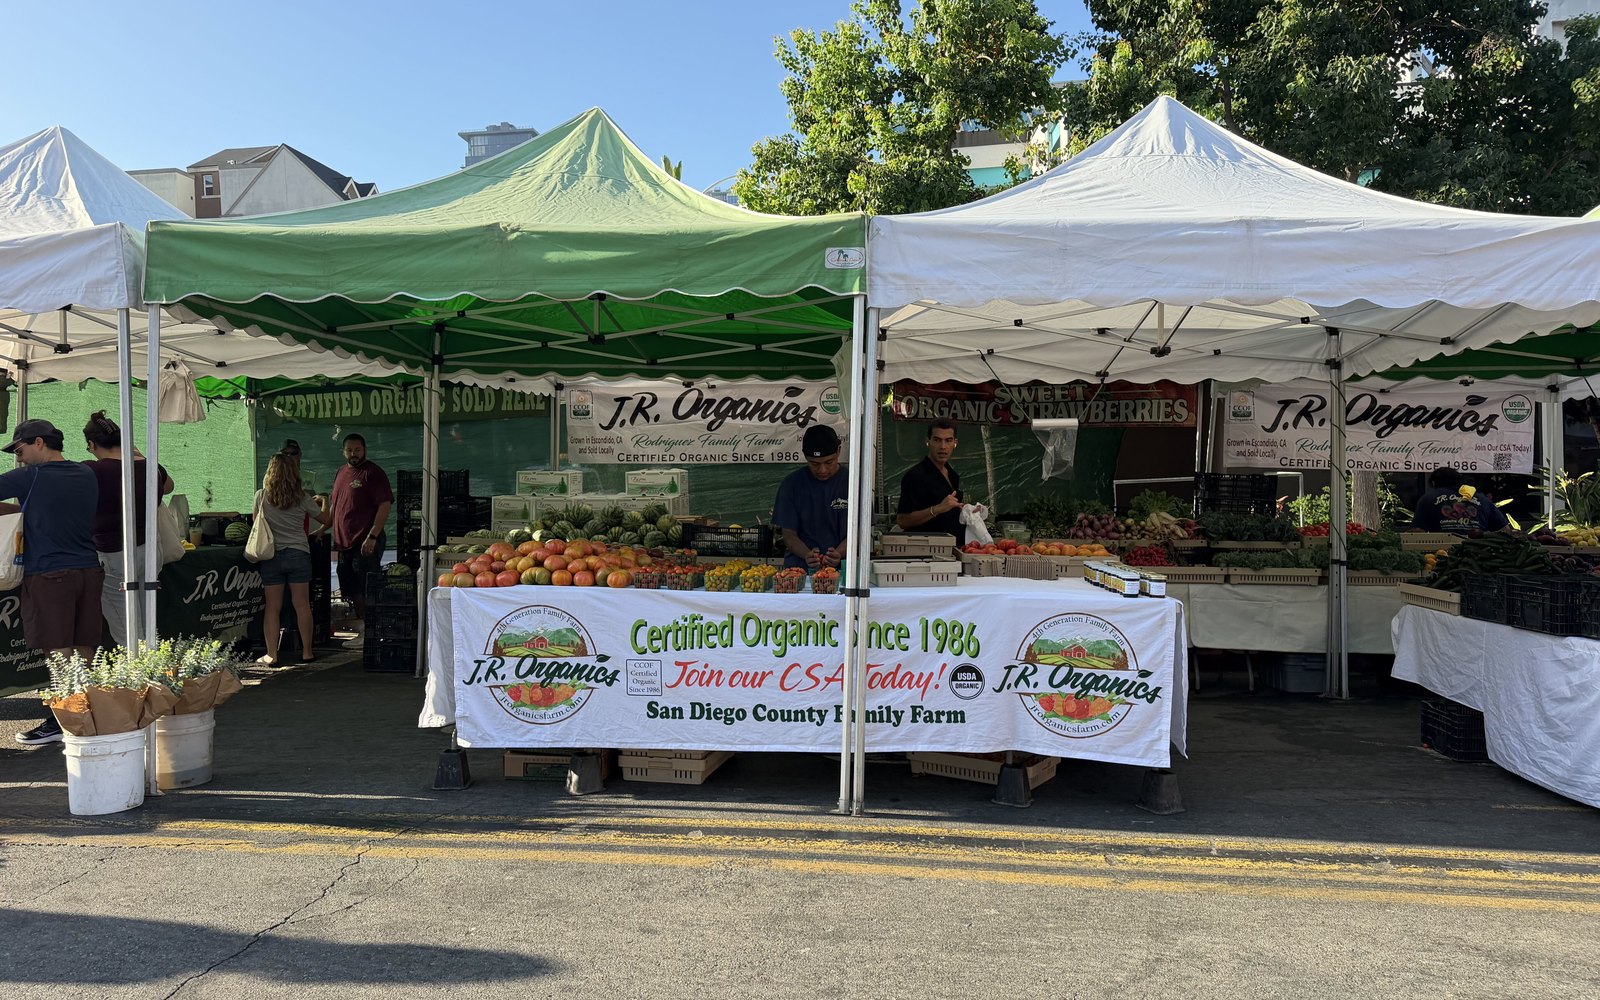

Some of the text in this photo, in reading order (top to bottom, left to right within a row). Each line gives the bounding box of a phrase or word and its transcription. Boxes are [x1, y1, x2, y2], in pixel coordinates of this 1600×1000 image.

[272, 386, 545, 418] CERTIFIED ORGANC SOLD HERE
[994, 385, 1088, 404] SWEET
[599, 388, 818, 431] J.R. Organics
[900, 395, 1189, 424] ORGANIC STRAWBERRIES
[1261, 393, 1500, 438] J.R. Organics
[570, 436, 584, 444] Grown
[591, 436, 616, 445] Escondido,
[616, 436, 623, 444] CA
[598, 446, 614, 456] Locally
[631, 434, 784, 452] Rodriguez Family Farms
[1226, 438, 1244, 446] Grown
[1252, 439, 1278, 448] Escondido,
[1367, 440, 1414, 459] Family
[1418, 440, 1462, 456] Farms
[1512, 444, 1532, 453] Today!
[618, 452, 799, 462] CERTIFIED ORGANIC SINCE 1986
[1247, 449, 1258, 457] Sold
[1259, 449, 1276, 459] Locally
[1280, 457, 1477, 471] CERTIFIE ORGANIC SINCE 1986
[1458, 517, 1469, 525] 40
[183, 570, 218, 604] J.R.
[497, 608, 582, 633] 4th Generation Family Farm
[1032, 616, 1125, 646] 4th Generation Family Farm
[630, 612, 980, 658] Certified Organic nce 1986
[462, 654, 620, 688] J.R. Organics
[665, 660, 726, 688] Join
[728, 670, 773, 688] our
[779, 663, 844, 692] CSA
[957, 672, 977, 681] USDA
[992, 662, 1162, 703] J.R. Organics
[500, 696, 583, 720] jrorganicsfarm.com
[646, 701, 684, 720] San
[690, 702, 747, 725] Diego
[753, 703, 828, 726] County
[910, 705, 966, 724] Farm
[1028, 704, 1120, 733] jrorganicsfarm.com
